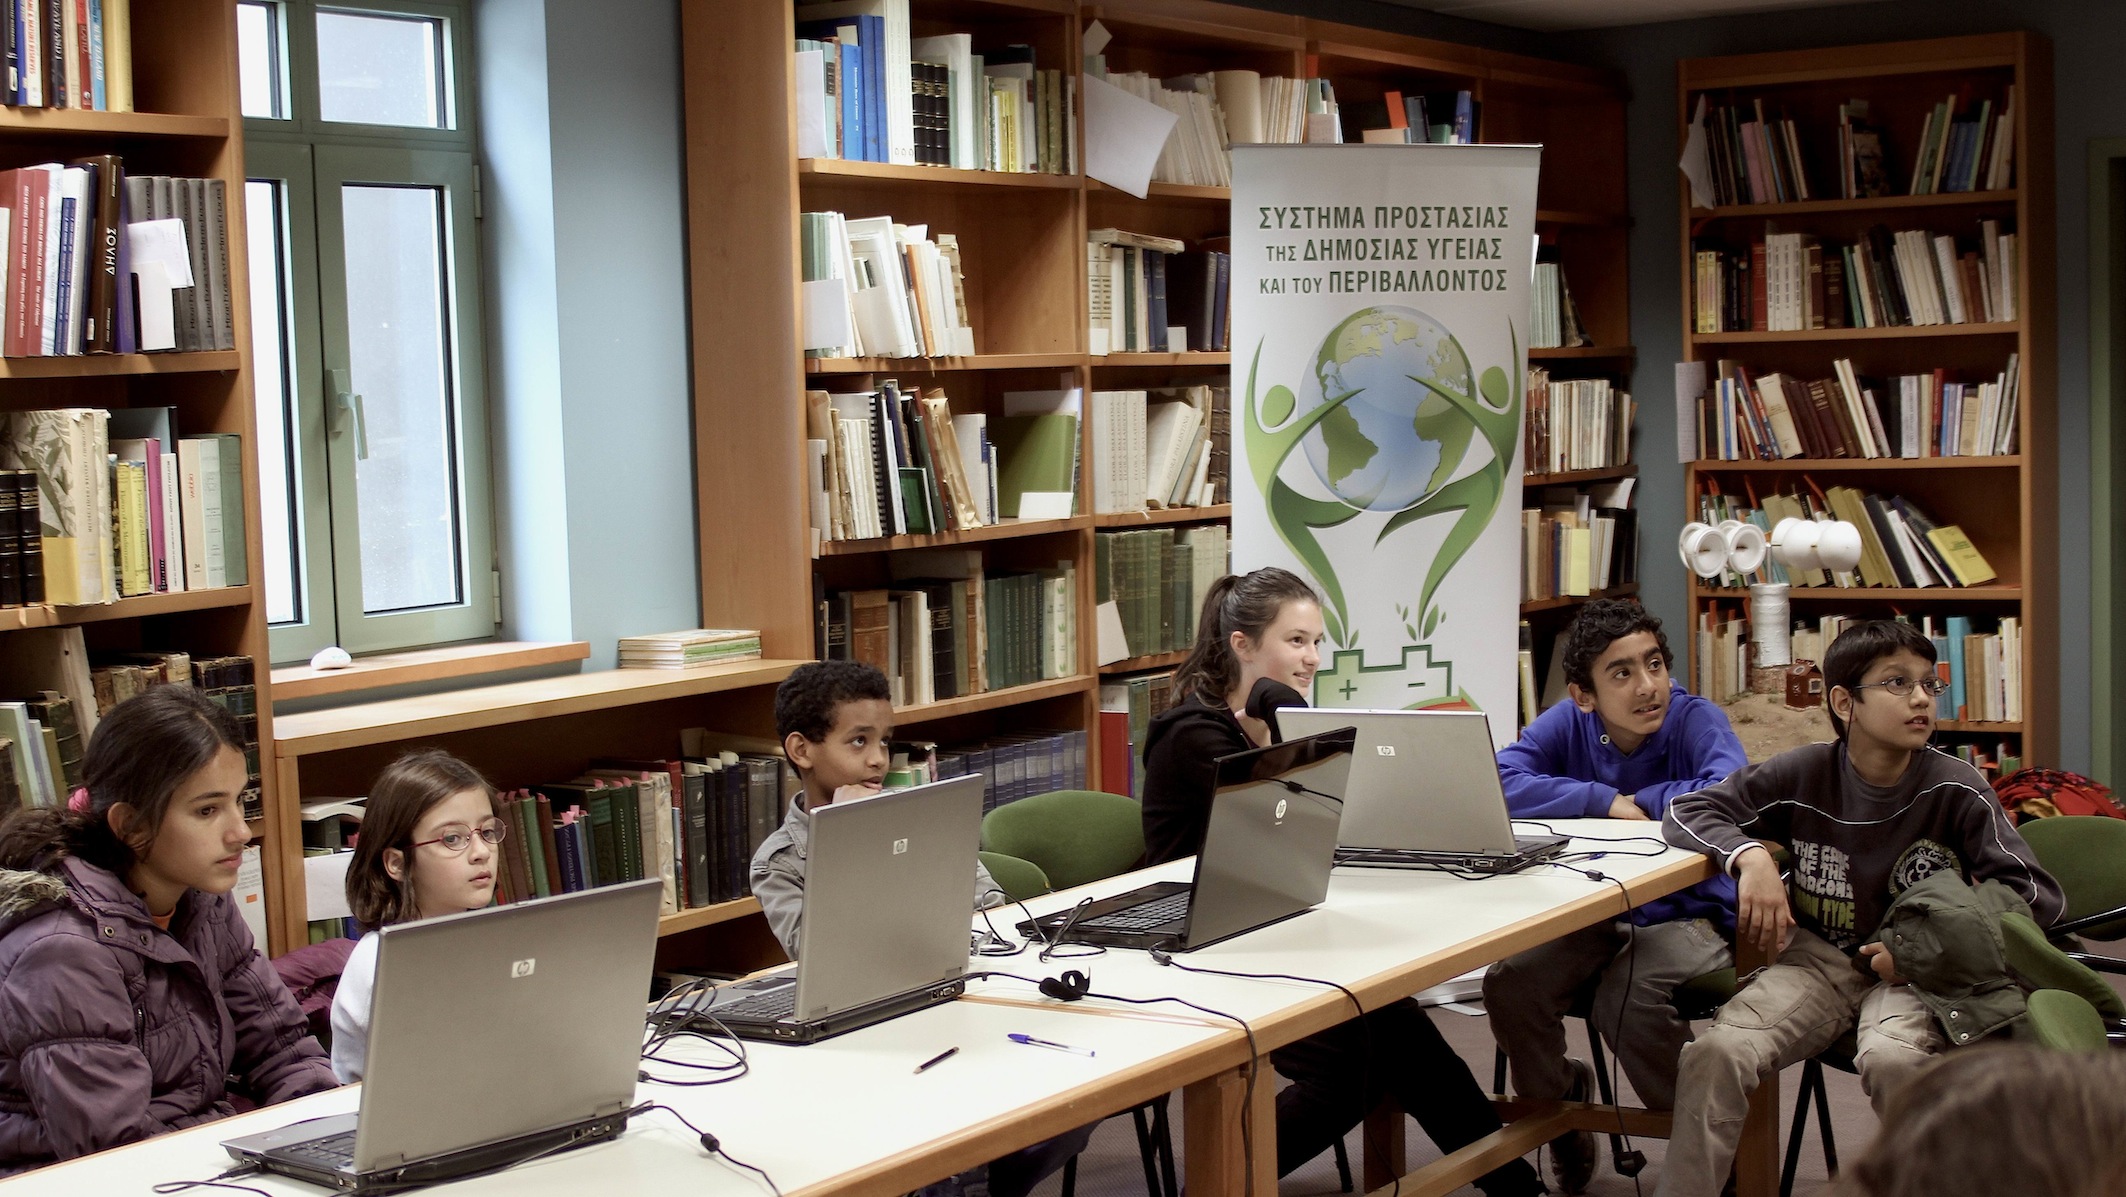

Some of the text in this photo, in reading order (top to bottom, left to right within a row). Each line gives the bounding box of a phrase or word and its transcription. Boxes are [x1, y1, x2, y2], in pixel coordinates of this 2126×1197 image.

[94, 45, 103, 81] ZEALAND
[1259, 206, 1509, 229] ΣΥΣΤΗΜΑ ΠΡΟΣΤΑΣΙΑΣ
[105, 227, 117, 276] ΔΗΛΟΣ
[1266, 238, 1502, 262] ΤΗΣ ΔΗΜΟΣΙΑΣ ΥΓΕΙΑΣ
[1260, 269, 1507, 294] ΚΑΙ ΤΟΥ ΠΕΡΙΒΑΛΛΟΝΤΟΣ
[1791, 838, 1819, 861] THE
[1799, 857, 1847, 882] OF THE
[1822, 899, 1855, 930] TYPE
